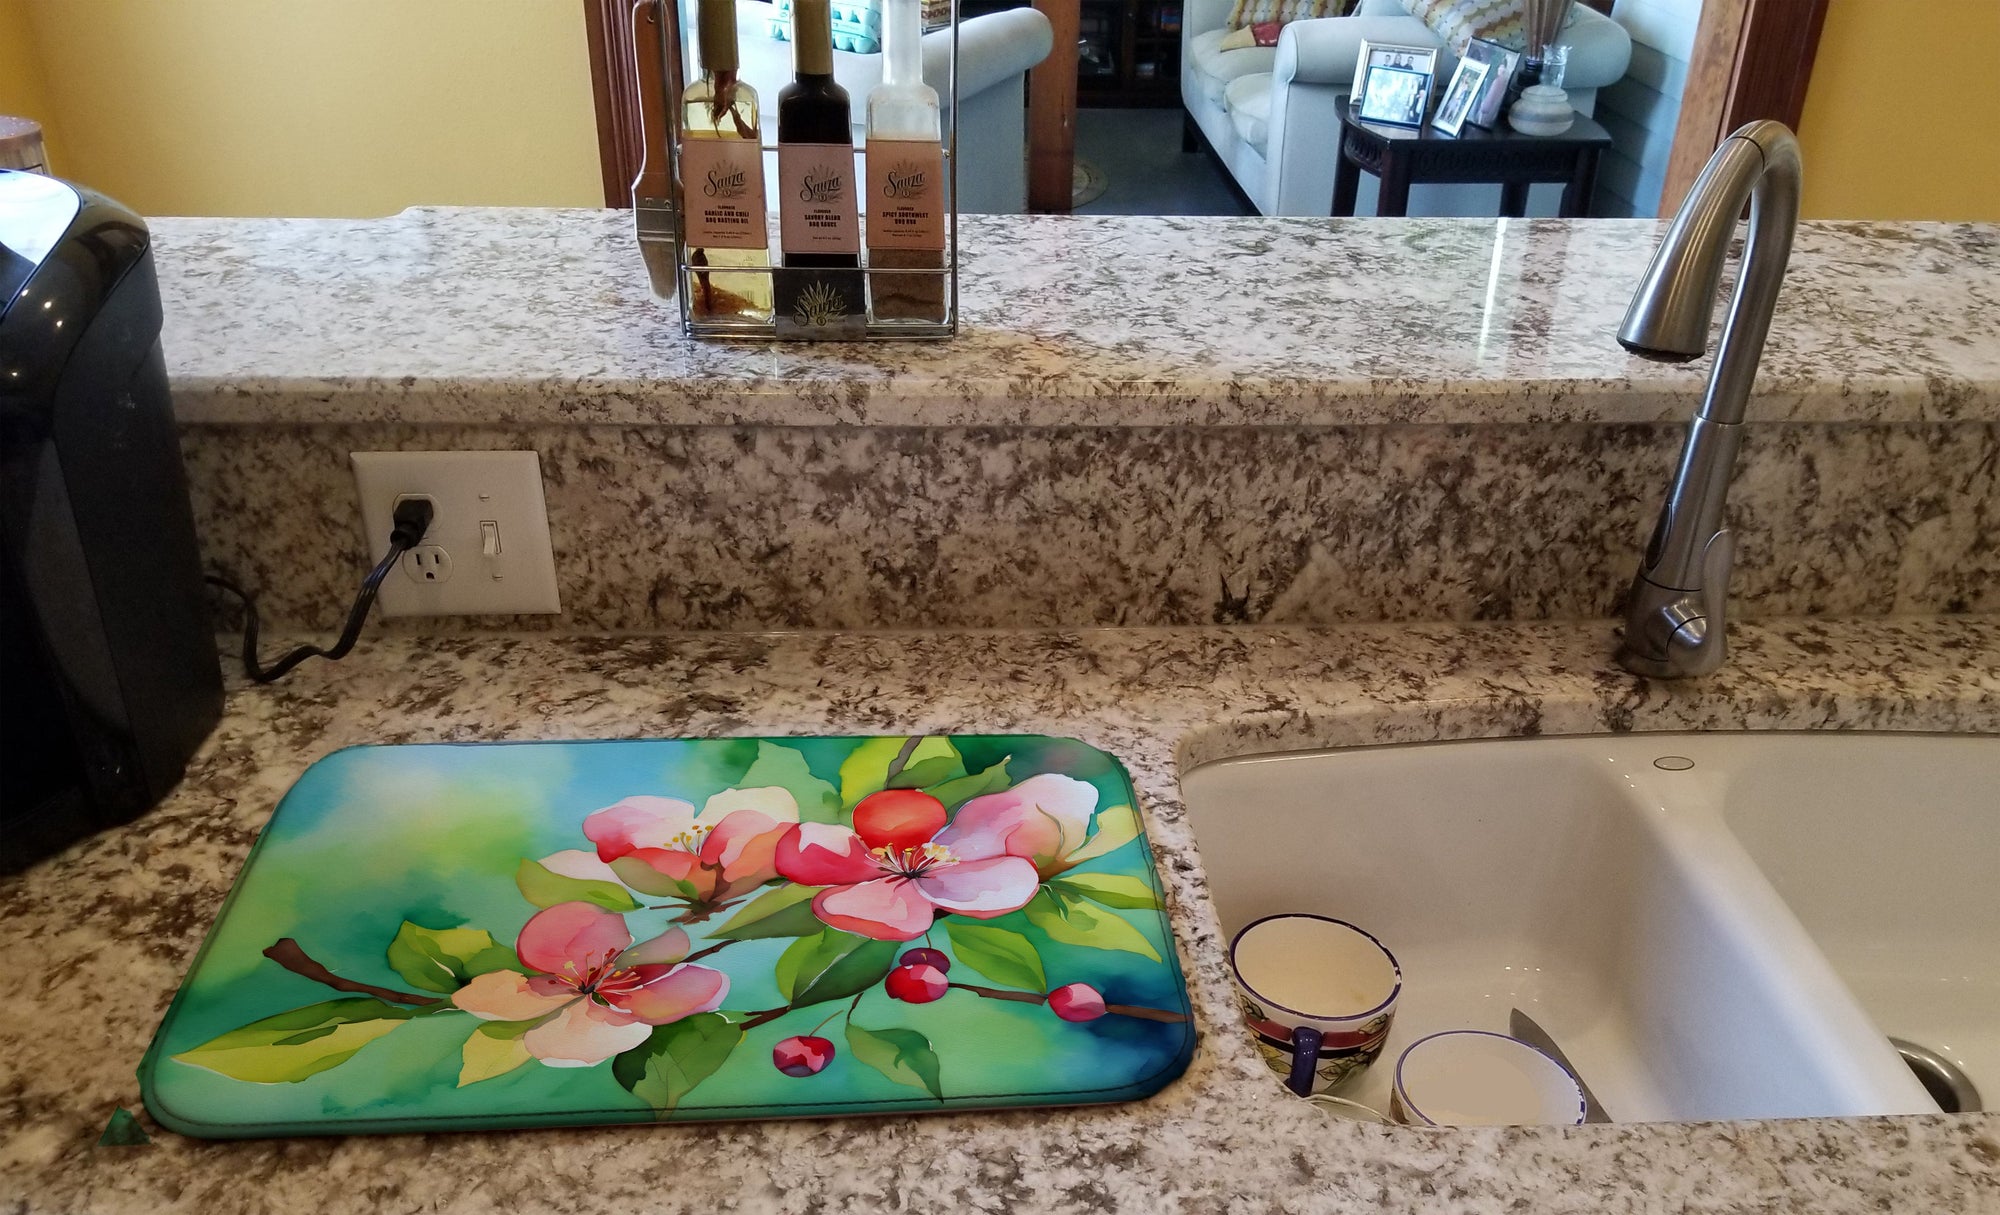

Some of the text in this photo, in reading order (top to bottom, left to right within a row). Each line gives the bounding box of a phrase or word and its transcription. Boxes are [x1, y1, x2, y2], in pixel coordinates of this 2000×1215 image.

[704, 170, 745, 197] Sauza
[800, 175, 841, 202] Sauza
[883, 171, 924, 198] Sauza
